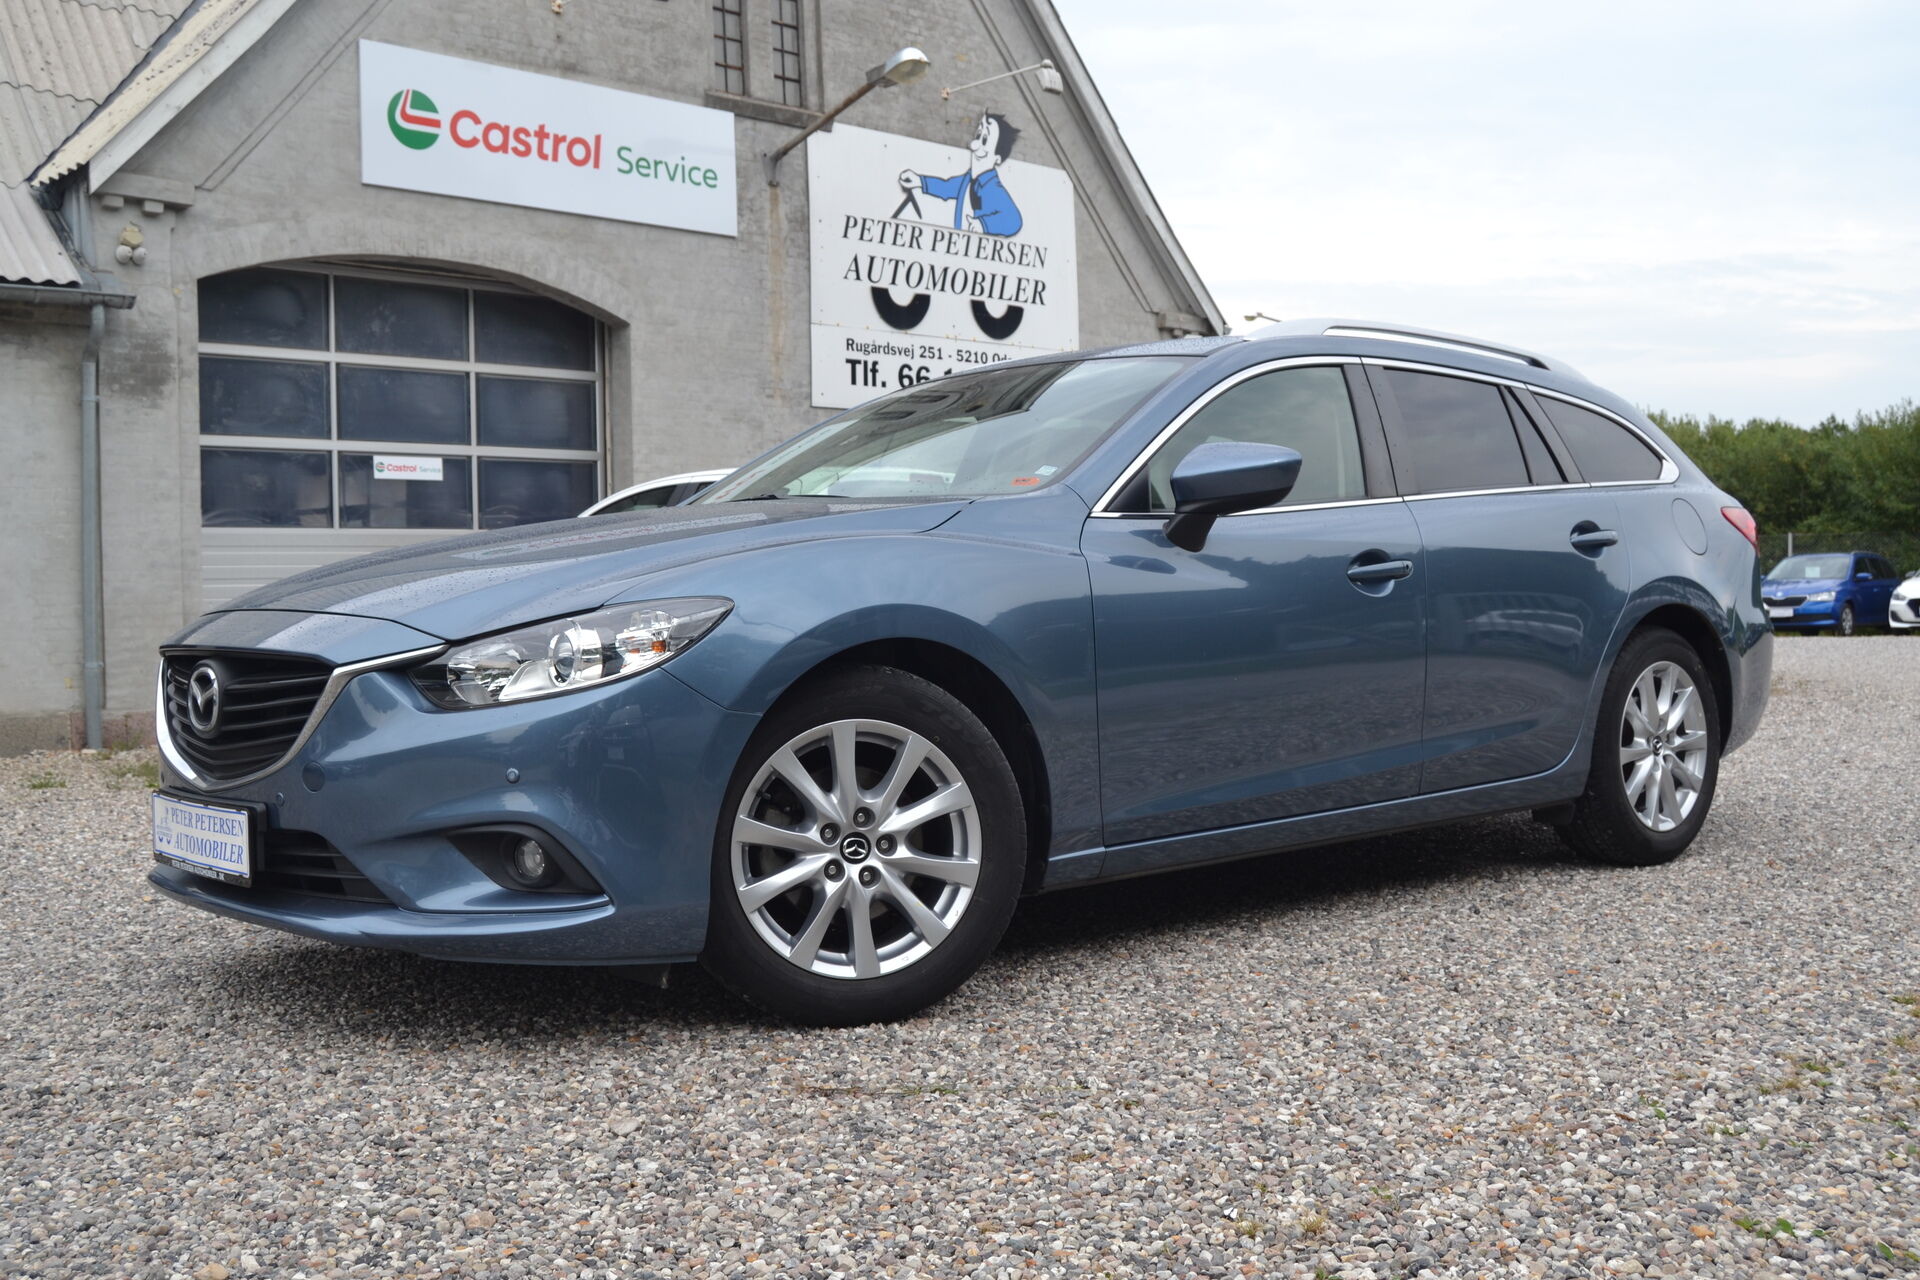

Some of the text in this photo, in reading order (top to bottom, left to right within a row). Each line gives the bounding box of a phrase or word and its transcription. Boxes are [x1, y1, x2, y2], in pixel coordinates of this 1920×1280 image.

[449, 109, 719, 188] Castrol Service
[842, 214, 1048, 269] PETER PETERSEN
[843, 252, 1047, 306] AUTOMOBILER
[846, 338, 915, 360] Rugårdsvej
[919, 345, 943, 360] 251
[956, 349, 988, 364] 5210
[845, 358, 887, 388] Tlf.
[386, 463, 417, 473] Castrol
[171, 807, 245, 838] PETER PETERSEN
[174, 832, 244, 865] AUTOMOBILER
